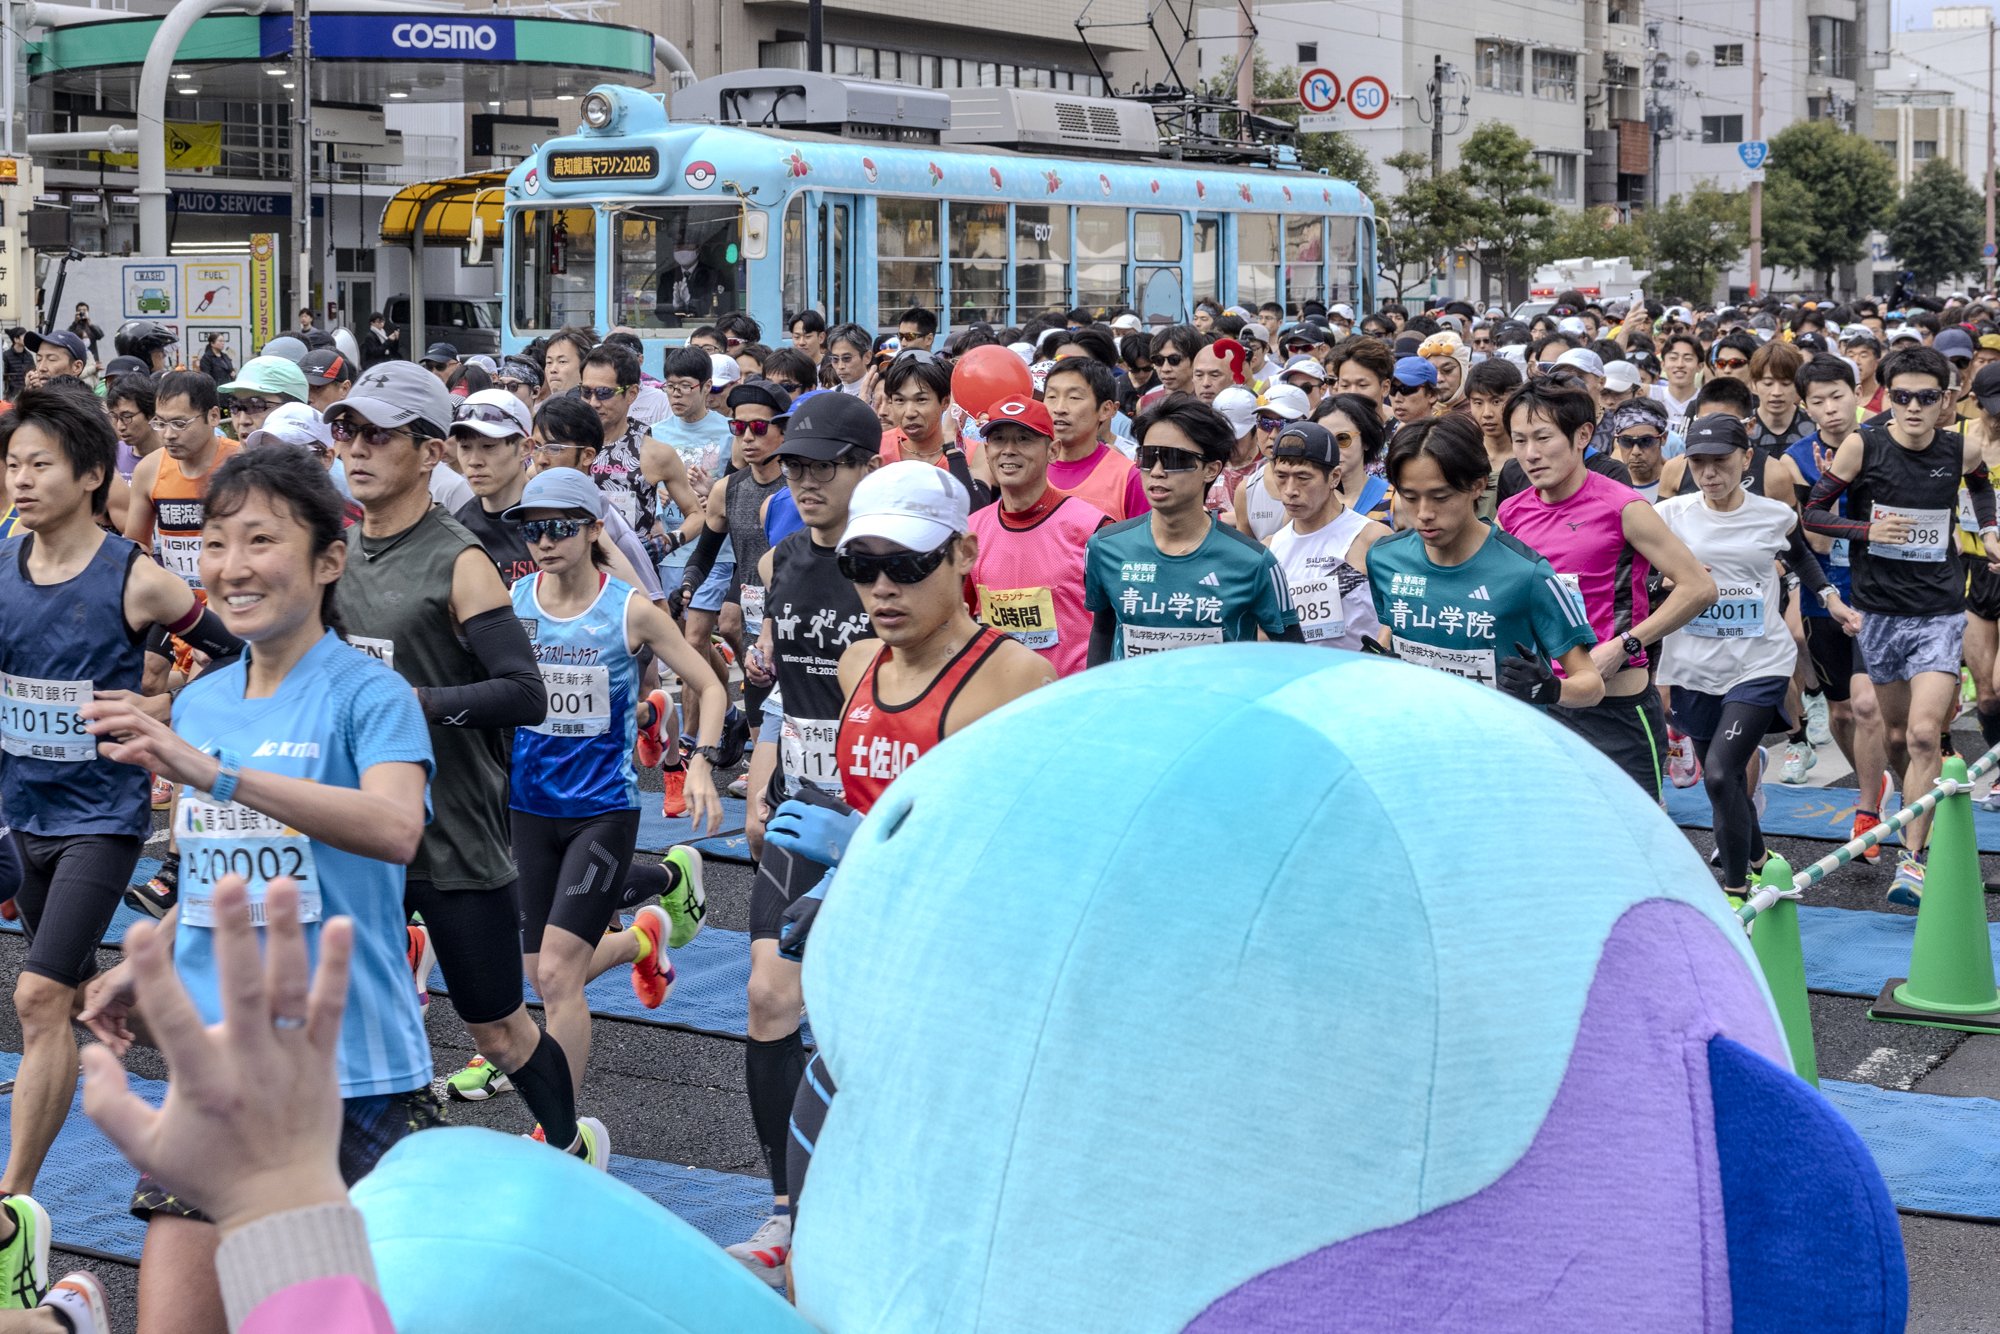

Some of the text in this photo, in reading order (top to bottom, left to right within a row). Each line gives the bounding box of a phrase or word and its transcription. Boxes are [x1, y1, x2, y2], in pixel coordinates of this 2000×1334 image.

[392, 23, 497, 51] COSMO
[1356, 88, 1380, 107] 50
[1744, 147, 1761, 160] 33
[553, 154, 651, 175] 高知龍馬マラソン2026
[178, 193, 273, 213] AUTO SERVICE
[1034, 224, 1053, 242] 607
[139, 271, 161, 280] WASH
[203, 271, 224, 280] FUEL
[666, 508, 674, 518] A
[1907, 528, 1939, 545] 098
[1133, 563, 1157, 573] 妙高市
[1131, 573, 1155, 583] 水上村
[1403, 576, 1427, 586] 妙高市
[1400, 586, 1424, 597] 水上村
[1119, 586, 1223, 624] 青山学院
[1297, 600, 1331, 622] 085
[1389, 598, 1496, 640] 青山学院
[1129, 628, 1215, 642] 青山学院大学ペースランナー
[1717, 627, 1744, 637] 高知市
[1400, 641, 1486, 664] 青山学院大学ペースランナー
[16, 682, 77, 702] 高知銀行
[550, 692, 593, 715] 001
[2, 706, 88, 735] A10158
[552, 723, 585, 735] 兵庫県
[31, 745, 66, 759] 広島県
[188, 846, 309, 886] A20002
